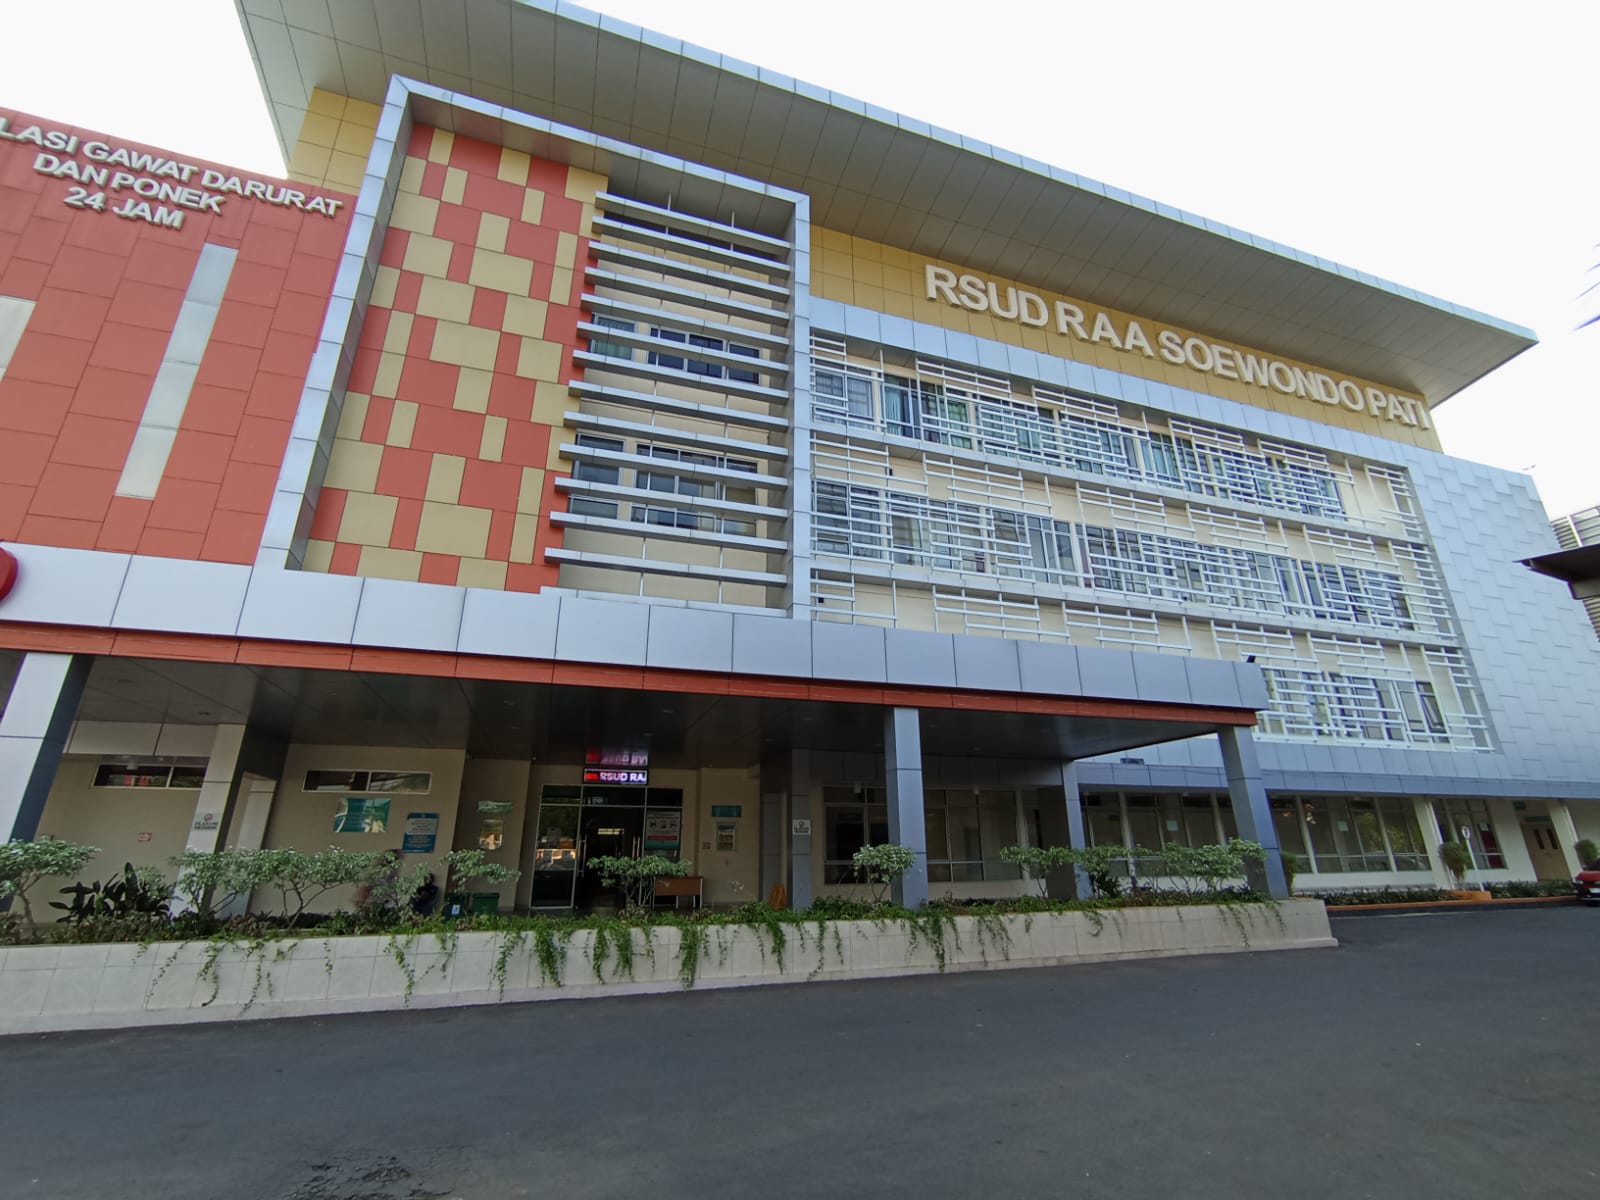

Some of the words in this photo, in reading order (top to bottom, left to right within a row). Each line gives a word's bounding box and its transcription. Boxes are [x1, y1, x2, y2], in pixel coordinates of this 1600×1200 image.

[0, 117, 78, 154] LASI
[83, 140, 198, 184] GAWAT
[201, 168, 343, 218] DARURAT
[33, 152, 109, 187] DAN
[111, 170, 226, 215] PONEK
[64, 186, 106, 213] 24
[112, 197, 186, 230] JAM
[925, 263, 1049, 328] RSUD
[1056, 299, 1155, 358] RAA
[1157, 329, 1365, 413] SOEWONDO
[1367, 385, 1431, 431] PATI
[600, 772, 628, 781] RSUD
